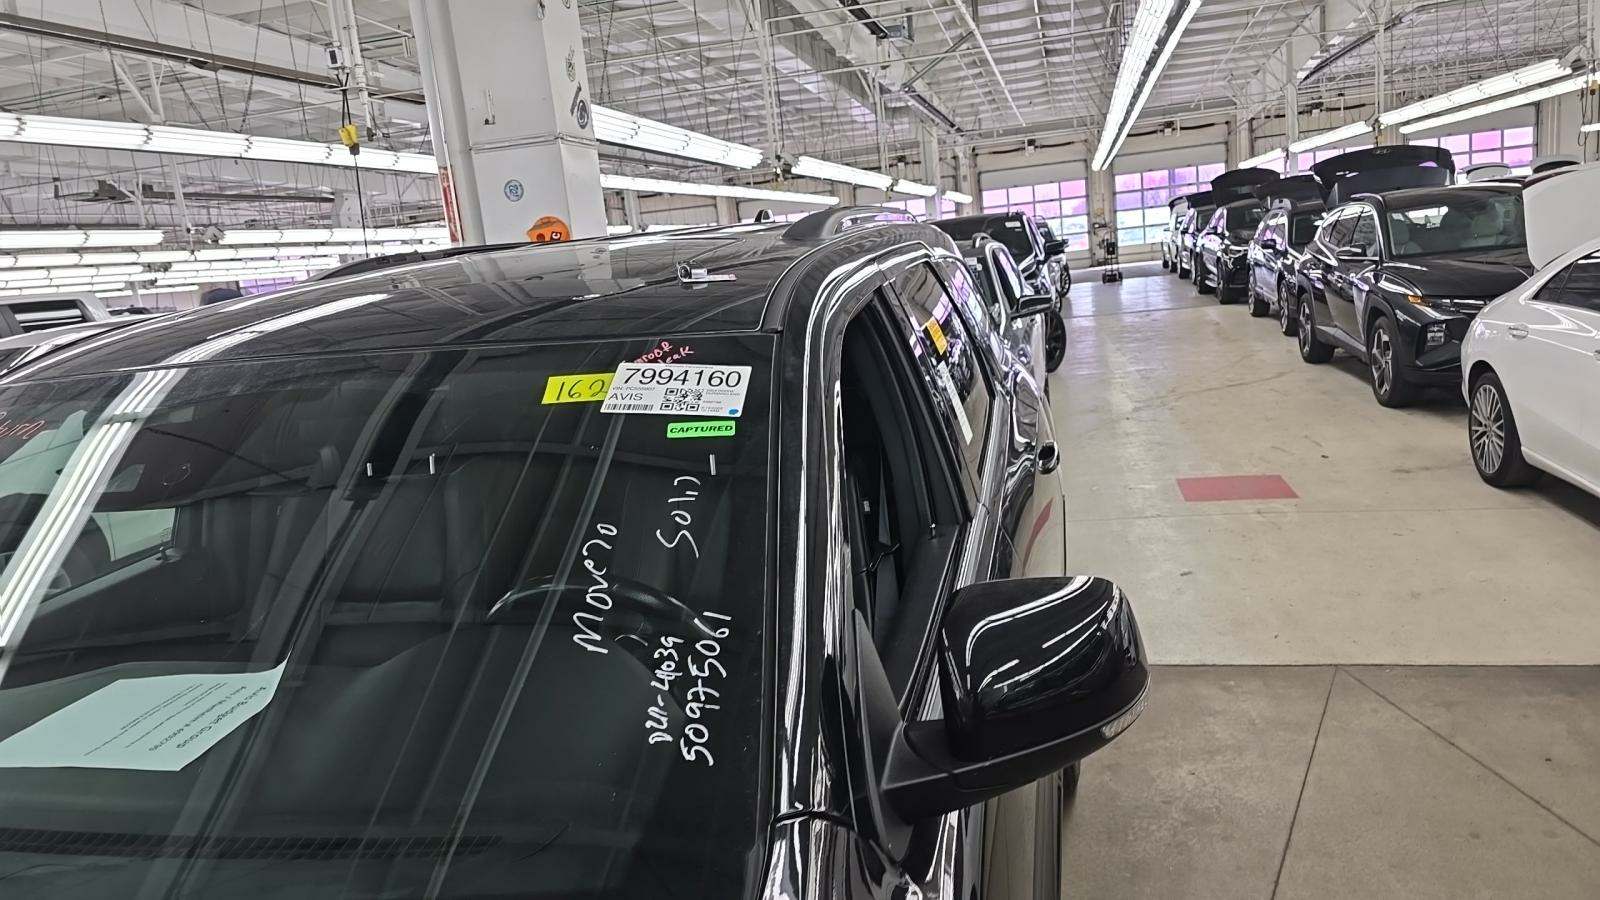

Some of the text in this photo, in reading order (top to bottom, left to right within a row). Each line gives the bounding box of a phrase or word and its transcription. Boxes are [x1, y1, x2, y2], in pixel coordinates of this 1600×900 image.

[623, 368, 742, 387] 7994160
[608, 393, 643, 401] AVIS
[669, 425, 734, 434] CAPTURED
